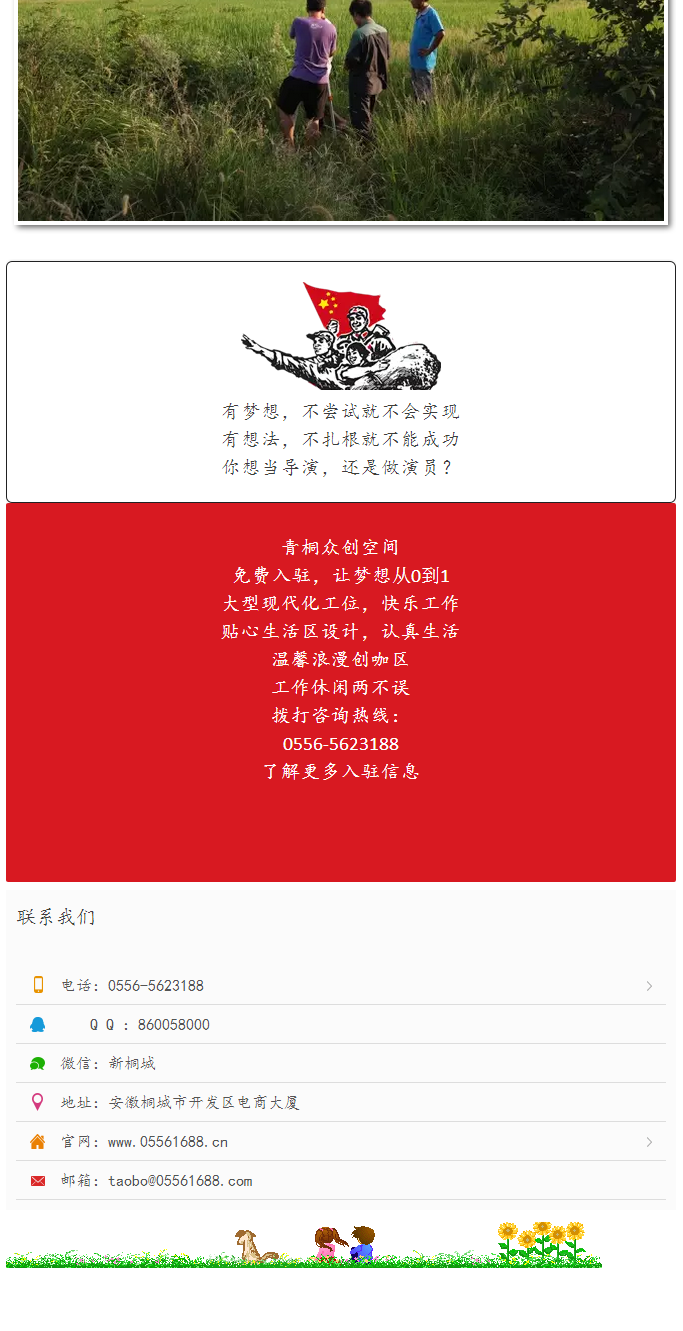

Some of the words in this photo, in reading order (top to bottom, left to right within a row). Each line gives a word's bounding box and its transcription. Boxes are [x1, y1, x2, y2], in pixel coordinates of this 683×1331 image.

[223, 403, 459, 421] 有梦想，不尝试就不会实现
[223, 431, 458, 449] 有想法，不扎根就不能成功
[222, 459, 451, 477] 你想当导演，还是做演员？
[282, 538, 398, 556] 青桐众创空间
[233, 566, 449, 585] 免费入驻，让梦想从0到1
[223, 594, 458, 613] 大型现代化工位，快乐工作
[221, 622, 459, 641] 贴心生活区设计，认真生活
[272, 651, 409, 668] 温馨浪漫创咖区
[272, 679, 410, 697] 工作休闲两不误
[272, 706, 399, 725] 拨打咨询热线：
[283, 738, 399, 751] 0556-5623188
[264, 762, 420, 780] 了解更多入驻信息
[17, 908, 95, 926] 联系我们
